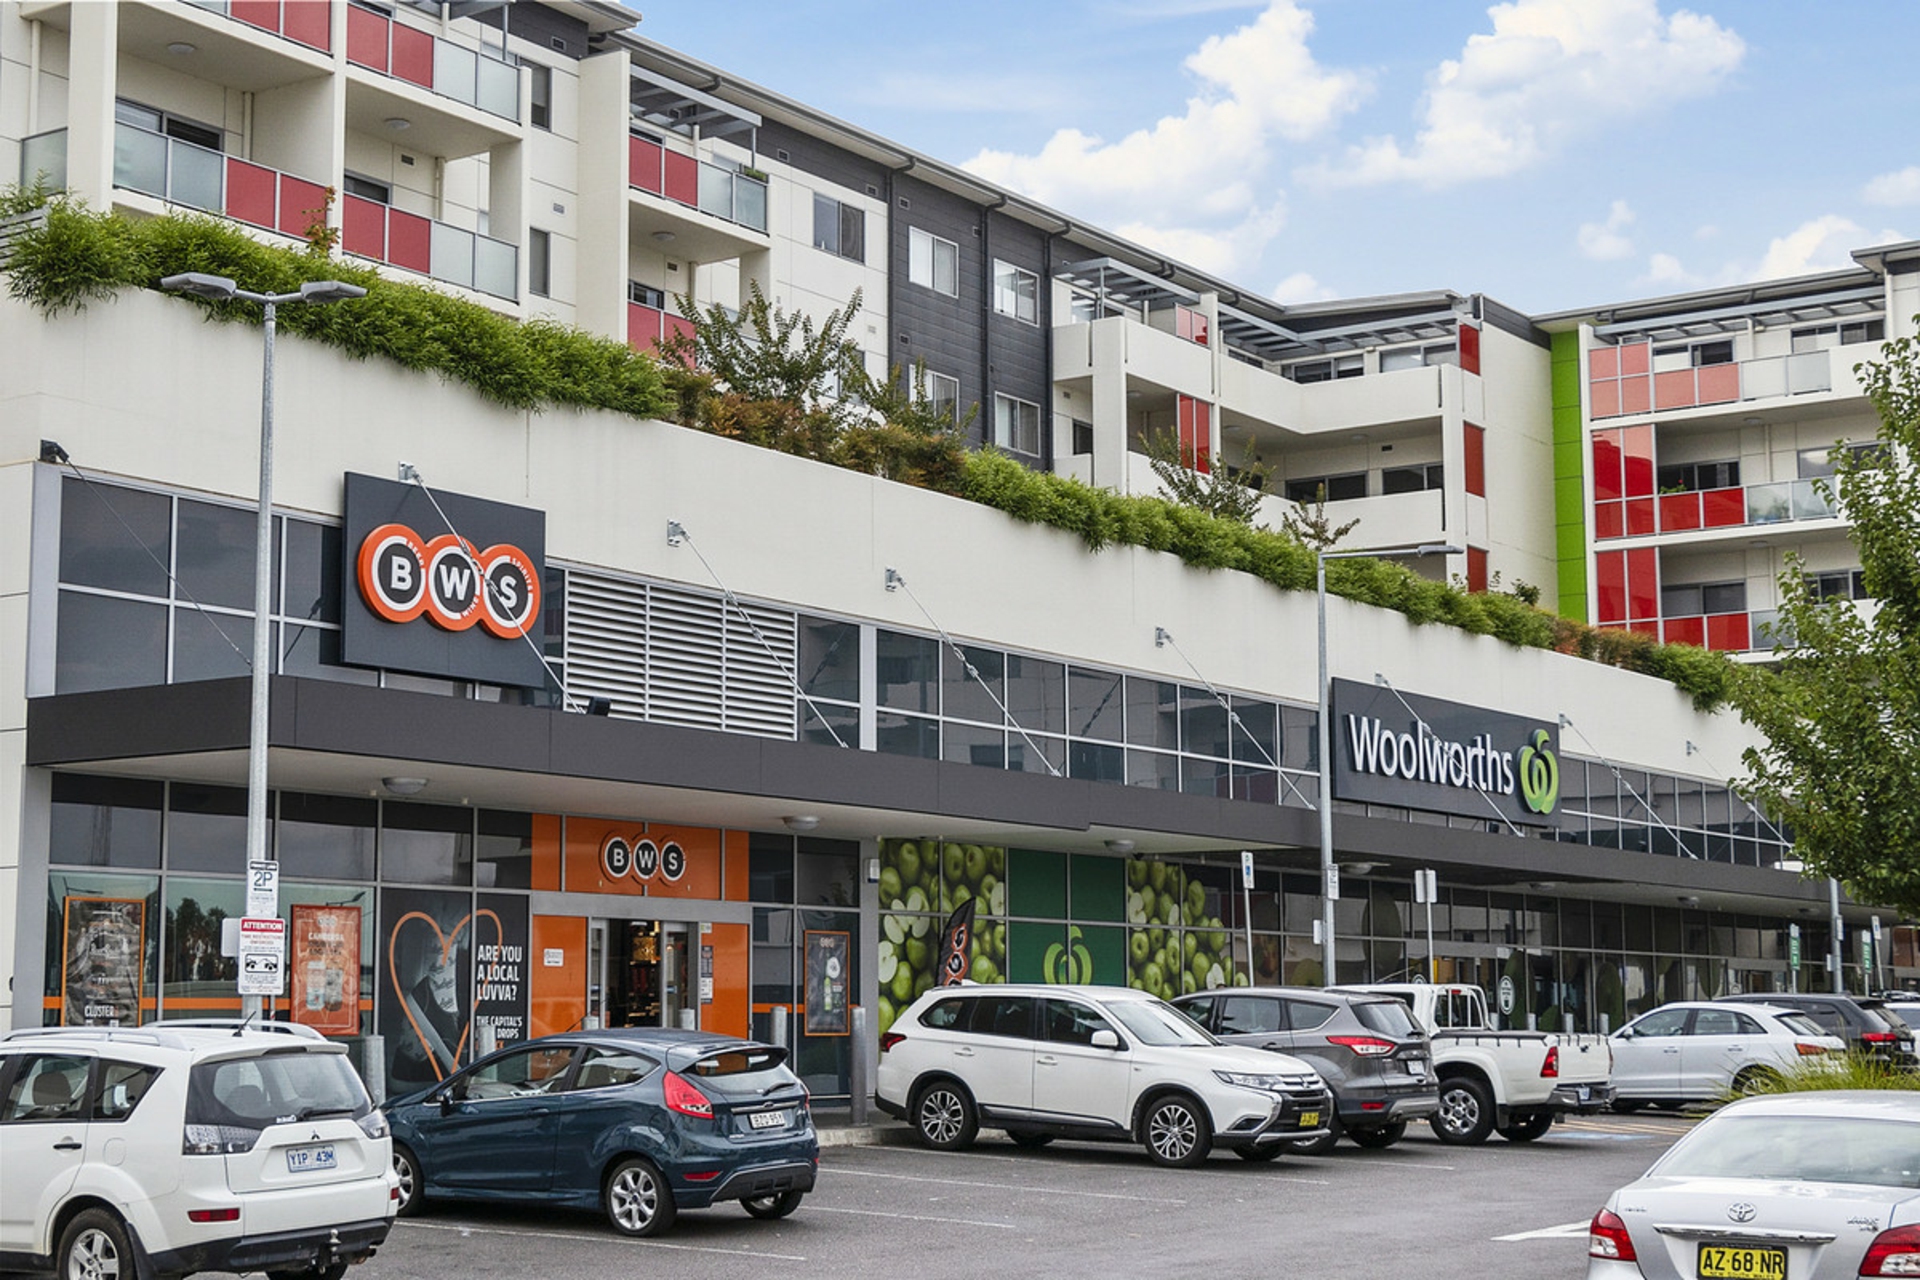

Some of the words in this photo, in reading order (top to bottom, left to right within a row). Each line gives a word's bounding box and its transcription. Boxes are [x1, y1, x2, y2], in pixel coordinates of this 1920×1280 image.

[406, 541, 425, 567] BEER
[391, 556, 517, 608] BWS
[510, 557, 534, 591] SPIRITS
[460, 596, 480, 619] WINE
[1348, 713, 1515, 796] Woolworths
[614, 848, 678, 870] BWS
[253, 870, 273, 887] 2P
[242, 921, 282, 930] ATTENTION
[477, 945, 499, 962] ARE
[500, 946, 523, 963] YOU
[477, 964, 485, 981] A
[487, 964, 520, 982] LOCAL
[476, 983, 518, 1001] LUVVA?
[476, 1015, 490, 1027] THE
[490, 1016, 523, 1028] CAPITAL'S
[497, 1028, 519, 1039] DROPS
